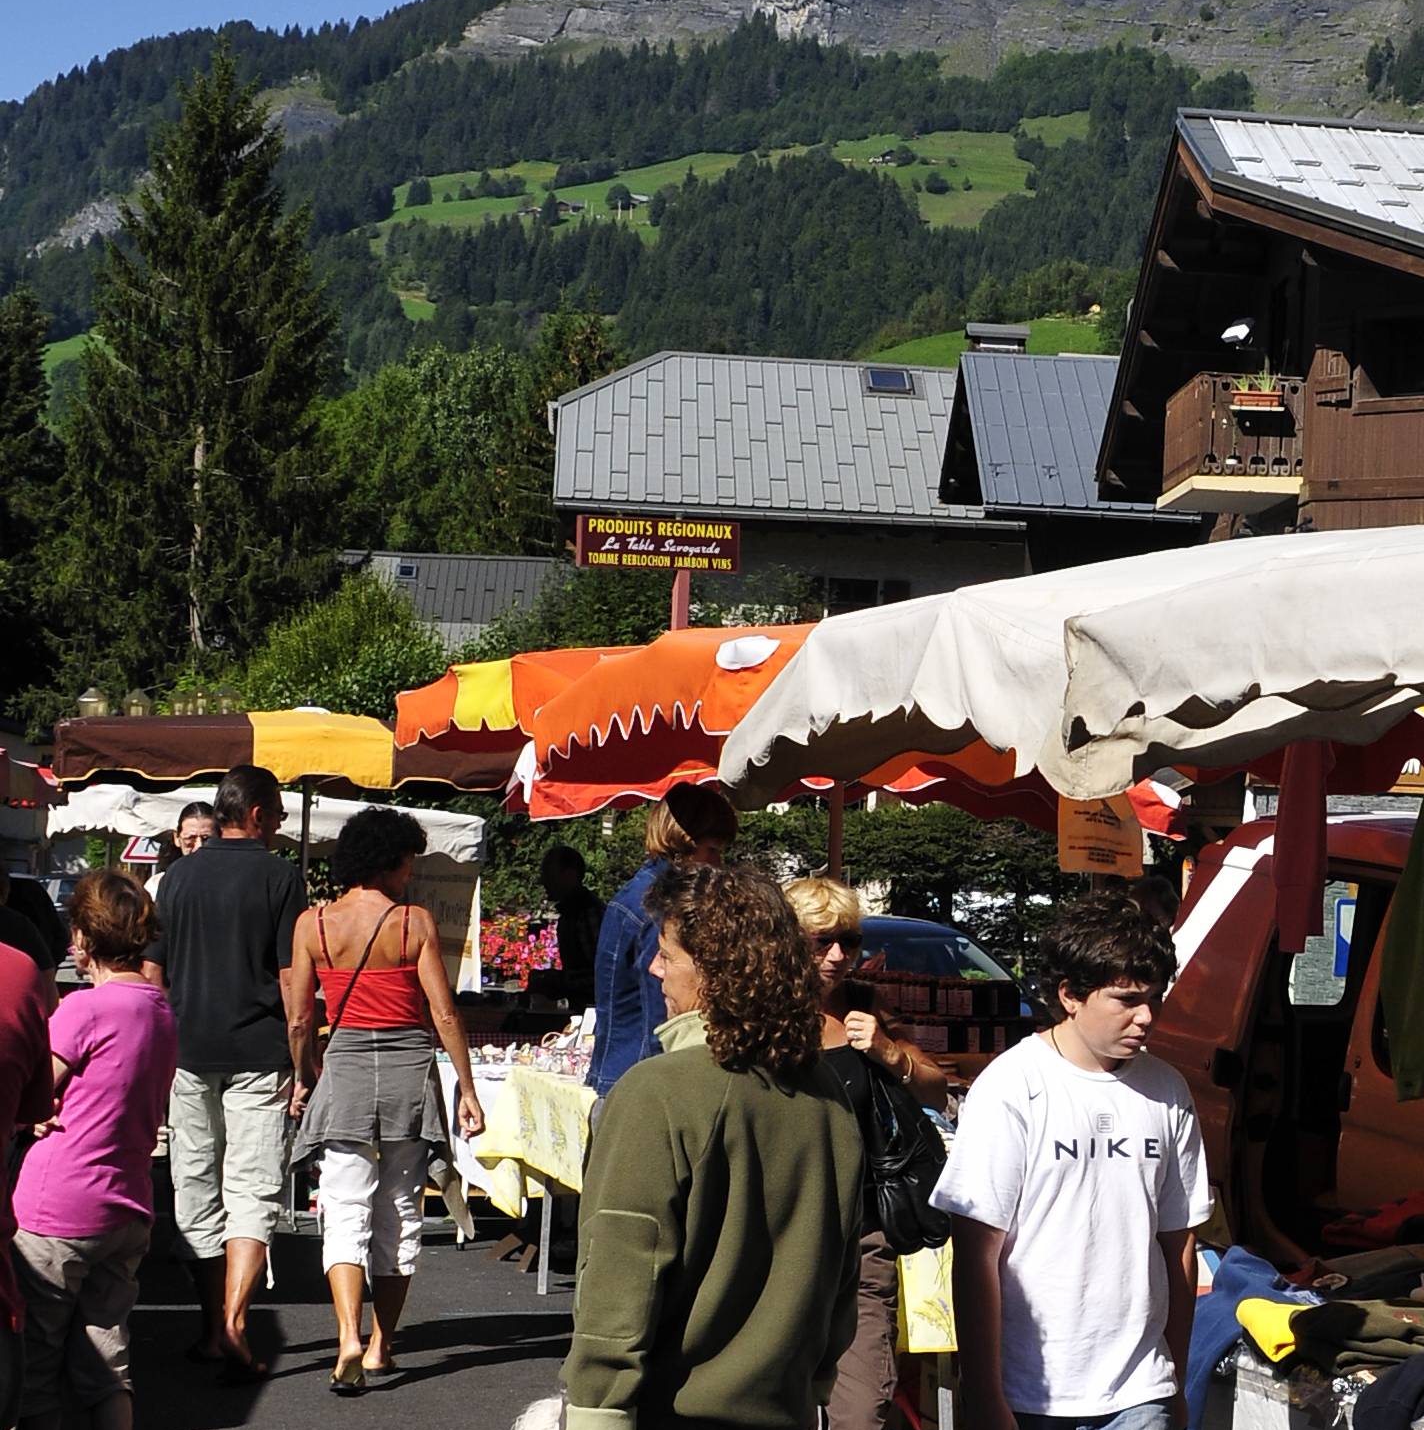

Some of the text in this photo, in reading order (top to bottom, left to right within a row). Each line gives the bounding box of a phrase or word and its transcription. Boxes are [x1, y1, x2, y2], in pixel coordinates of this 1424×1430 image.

[588, 518, 733, 540] PRODUITS REGIONAUX
[601, 536, 721, 556] La Table Savoyarde
[588, 552, 732, 570] TOMME REBLOCHON JAMBON VINS
[1054, 1137, 1161, 1161] NIKE
